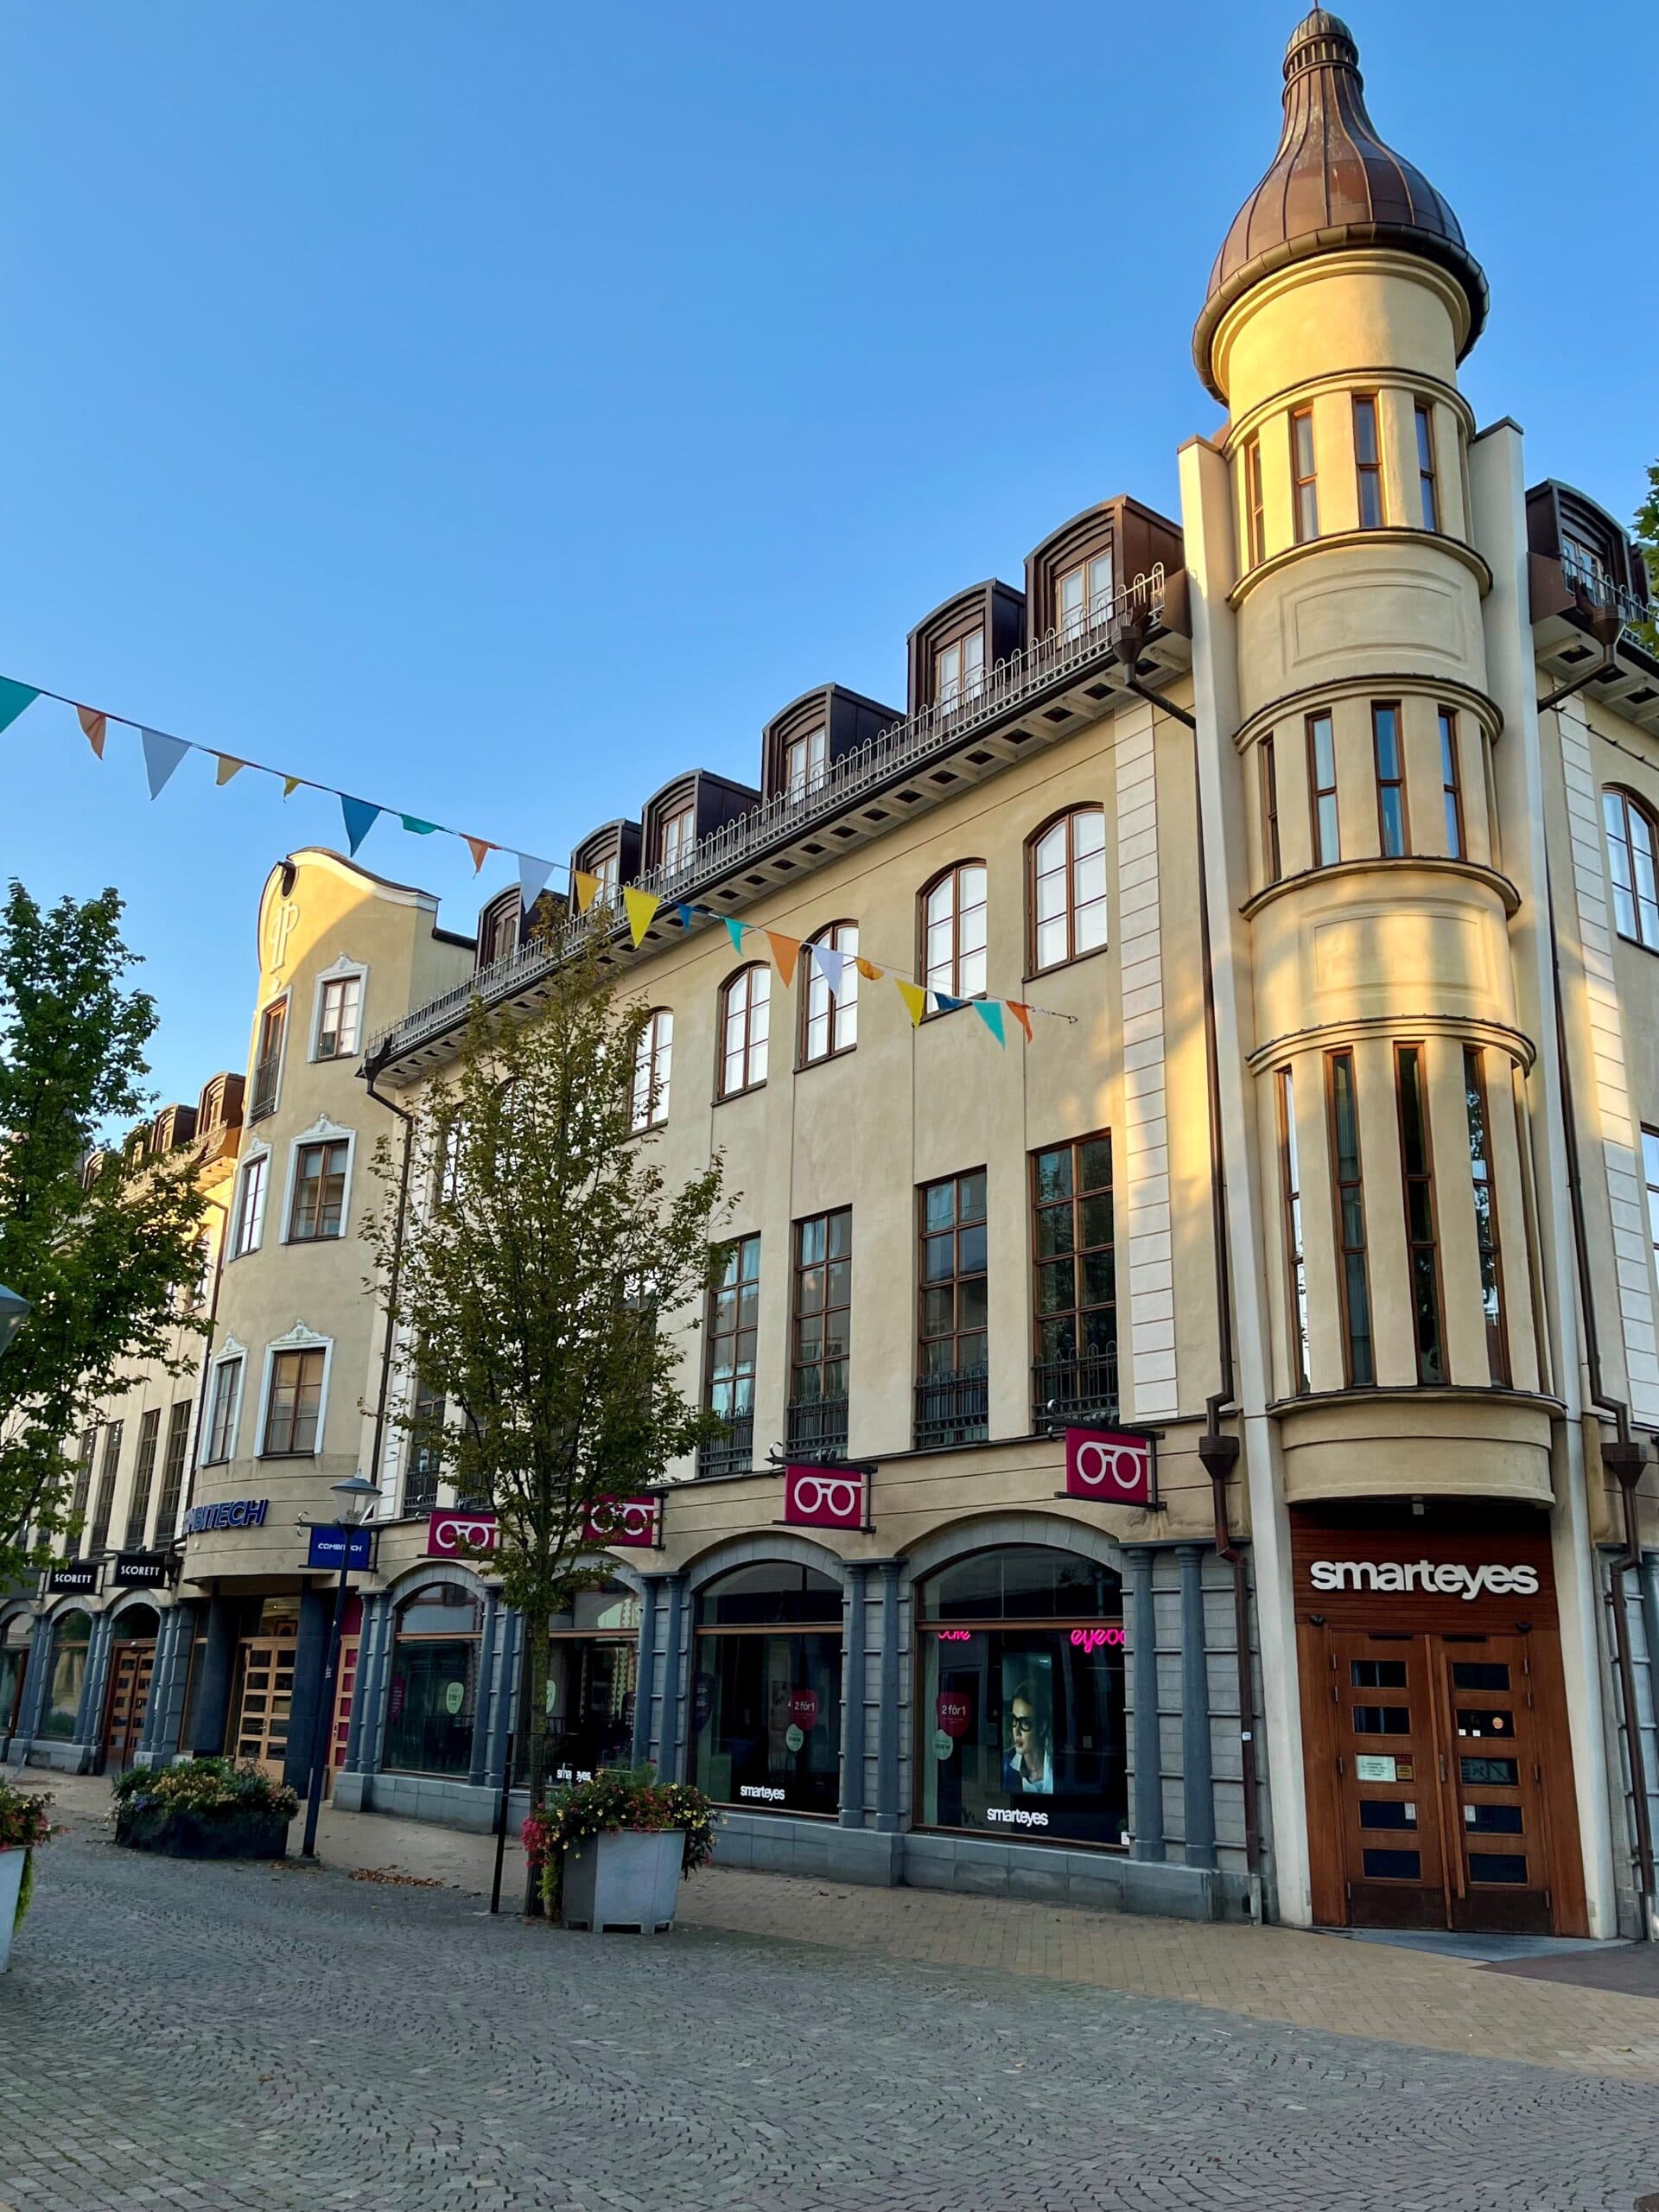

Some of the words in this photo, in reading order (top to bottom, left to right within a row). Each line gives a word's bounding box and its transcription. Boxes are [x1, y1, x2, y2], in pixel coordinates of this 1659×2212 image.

[318, 1543, 362, 1552] COMBITCH
[121, 1565, 160, 1577] SCORETT
[54, 1573, 92, 1584] SCORETT
[1310, 1560, 1539, 1600] smarteyes
[794, 1701, 800, 1711] 2
[800, 1700, 810, 1712] för
[941, 1705, 947, 1715] 2
[948, 1704, 961, 1716] för
[962, 1706, 966, 1716] 1
[556, 1769, 591, 1783] smaeyes
[740, 1785, 785, 1801] smarteyes
[987, 1808, 1049, 1827] smarteyes
